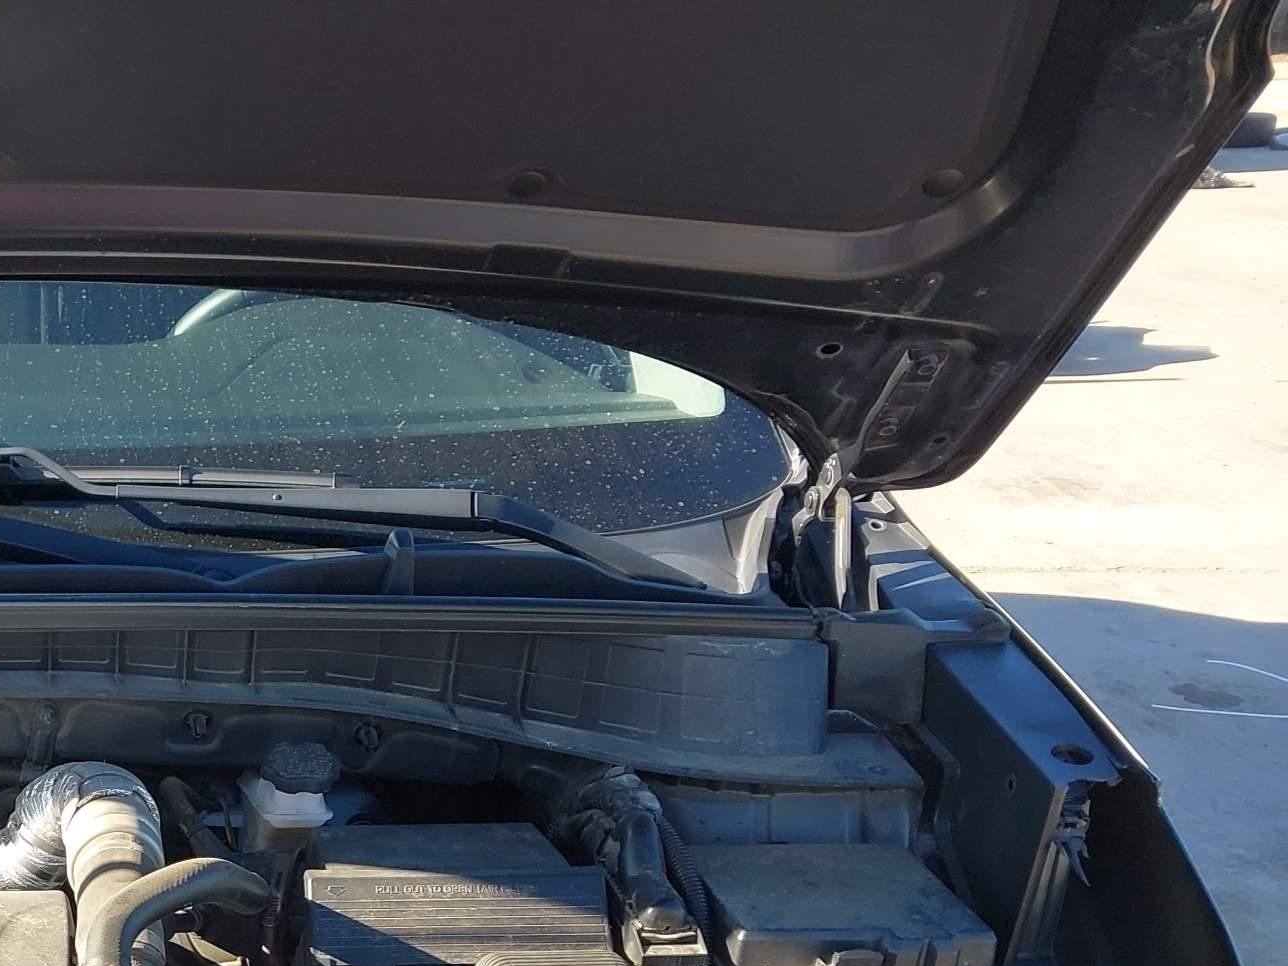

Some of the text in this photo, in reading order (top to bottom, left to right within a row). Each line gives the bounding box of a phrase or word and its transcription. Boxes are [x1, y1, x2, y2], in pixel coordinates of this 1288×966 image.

[375, 885, 401, 894] PULL
[403, 884, 425, 894] OUT
[443, 884, 474, 893] OPEN
